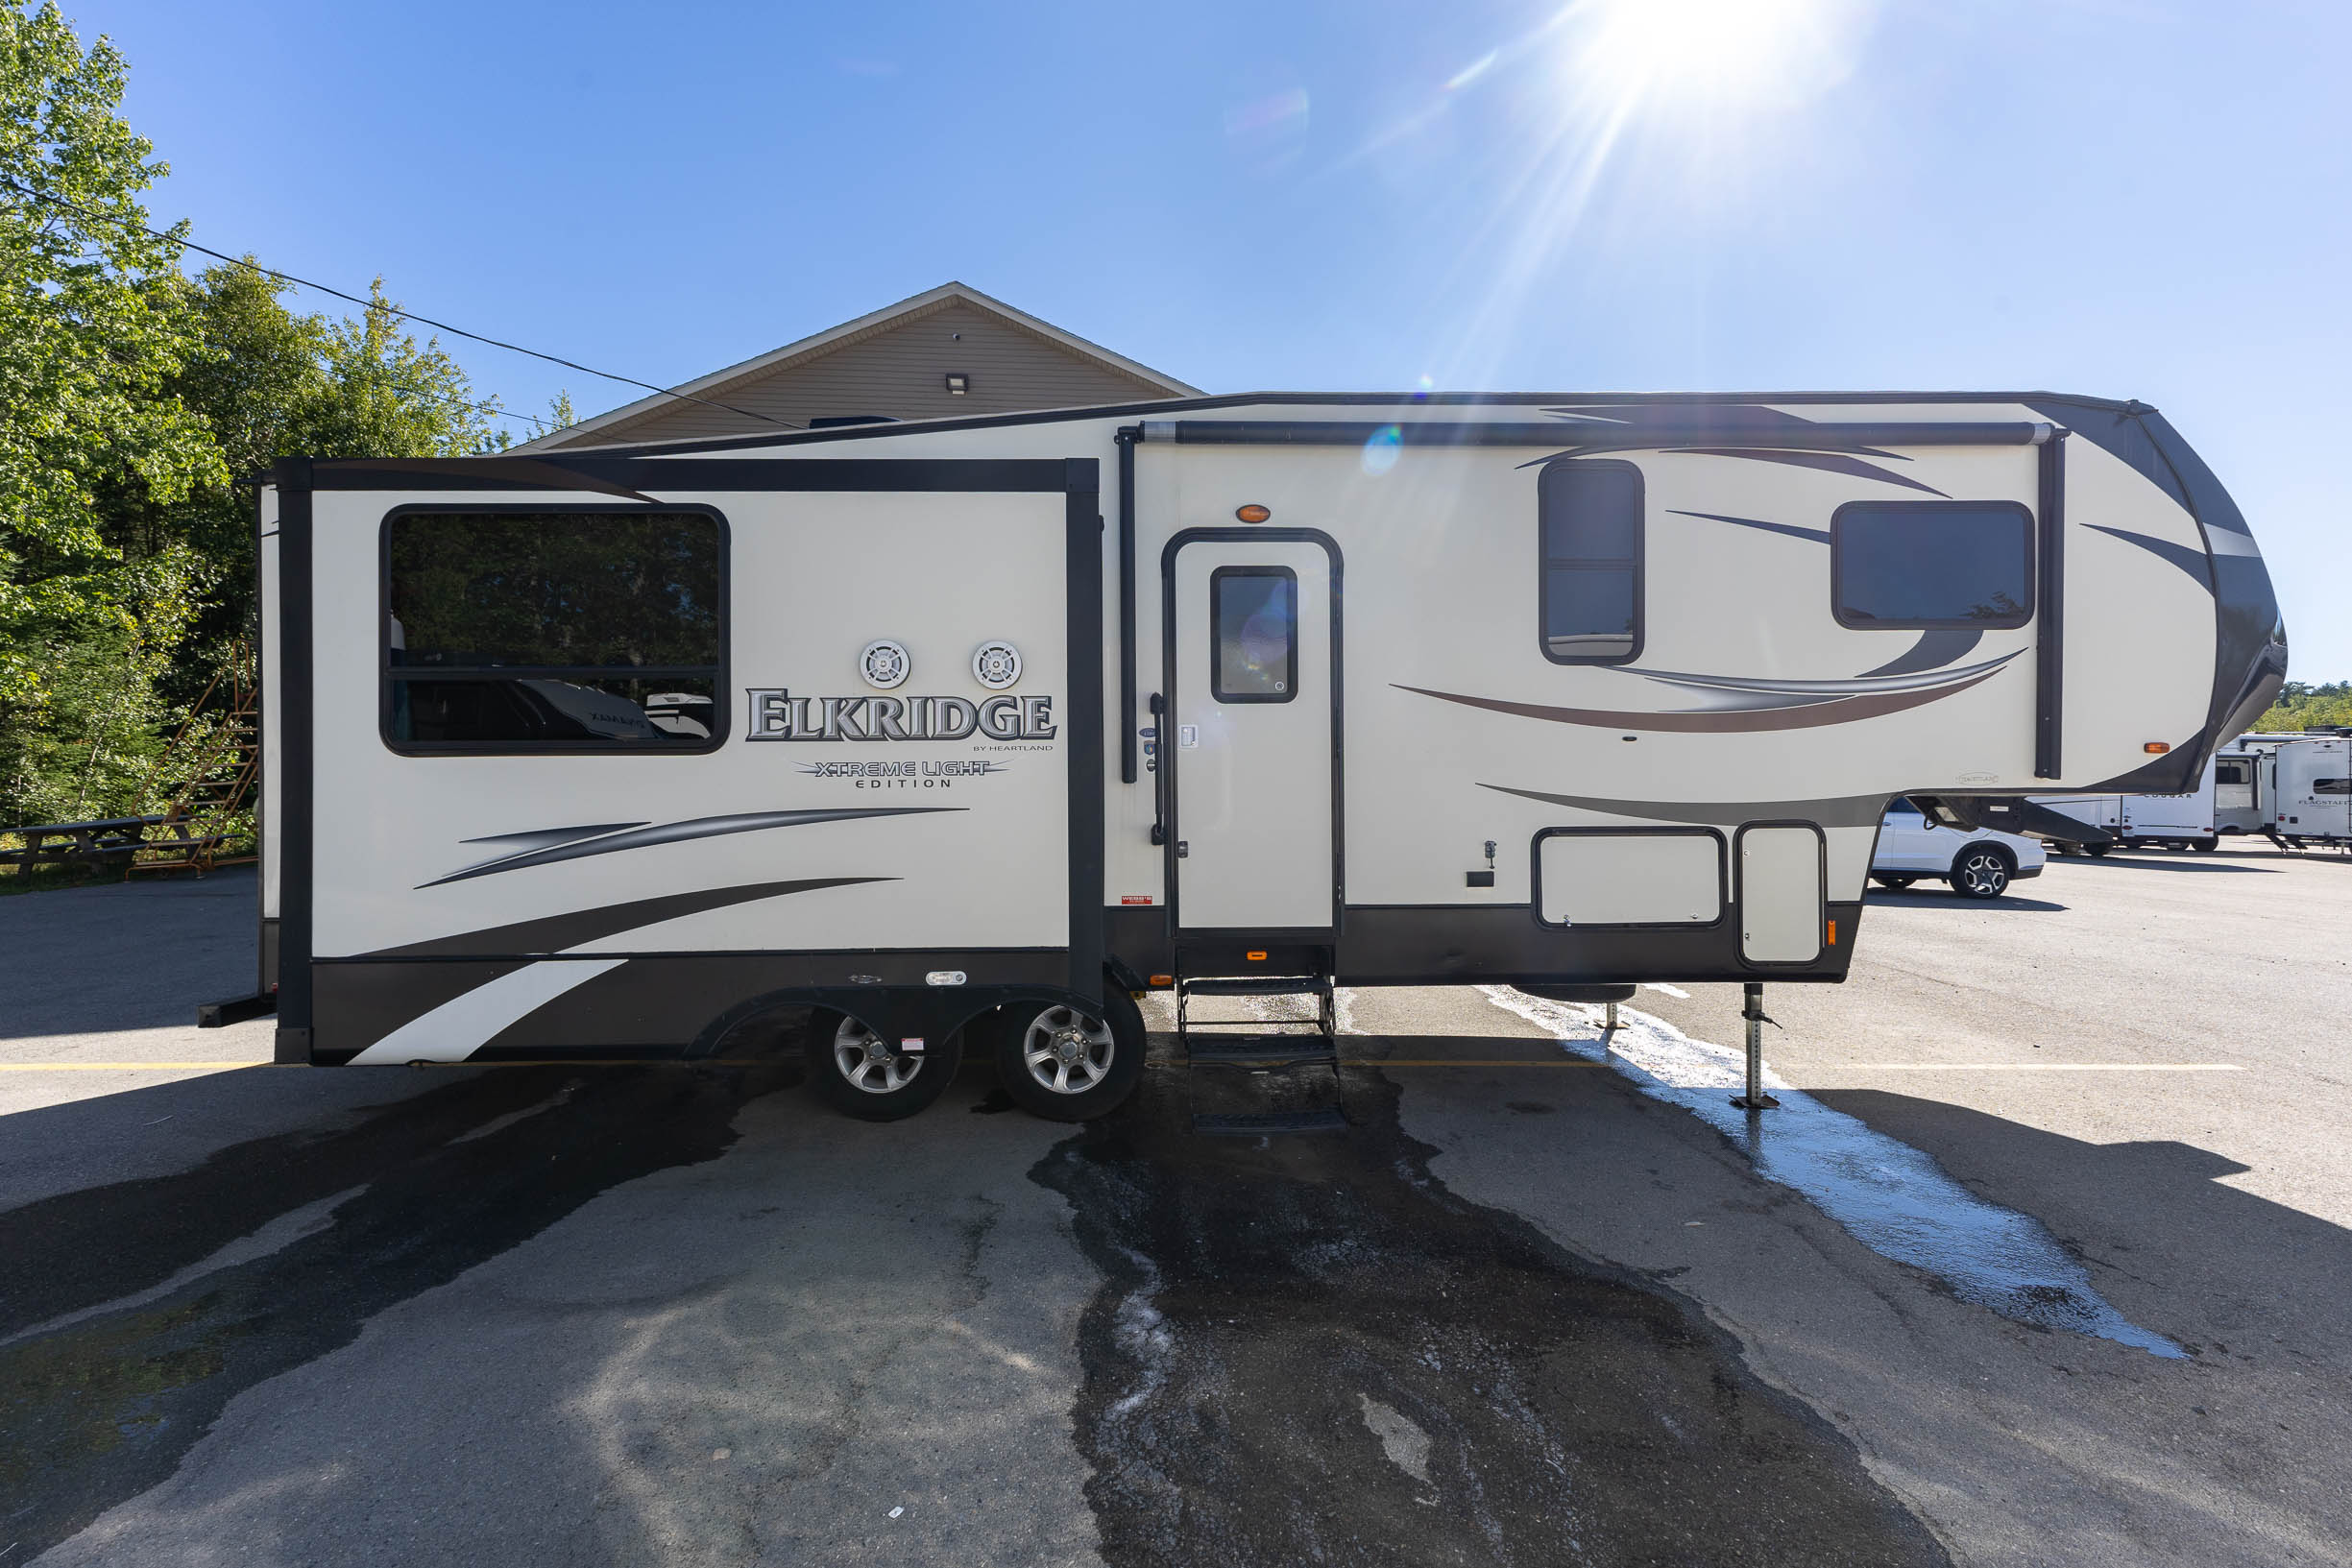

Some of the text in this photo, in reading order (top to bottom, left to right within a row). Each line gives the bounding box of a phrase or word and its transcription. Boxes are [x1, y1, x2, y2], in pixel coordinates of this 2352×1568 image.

[745, 688, 1058, 742] ELKRIDGE
[814, 761, 990, 778] XTREME LIGHT
[856, 779, 951, 788] EDITION
